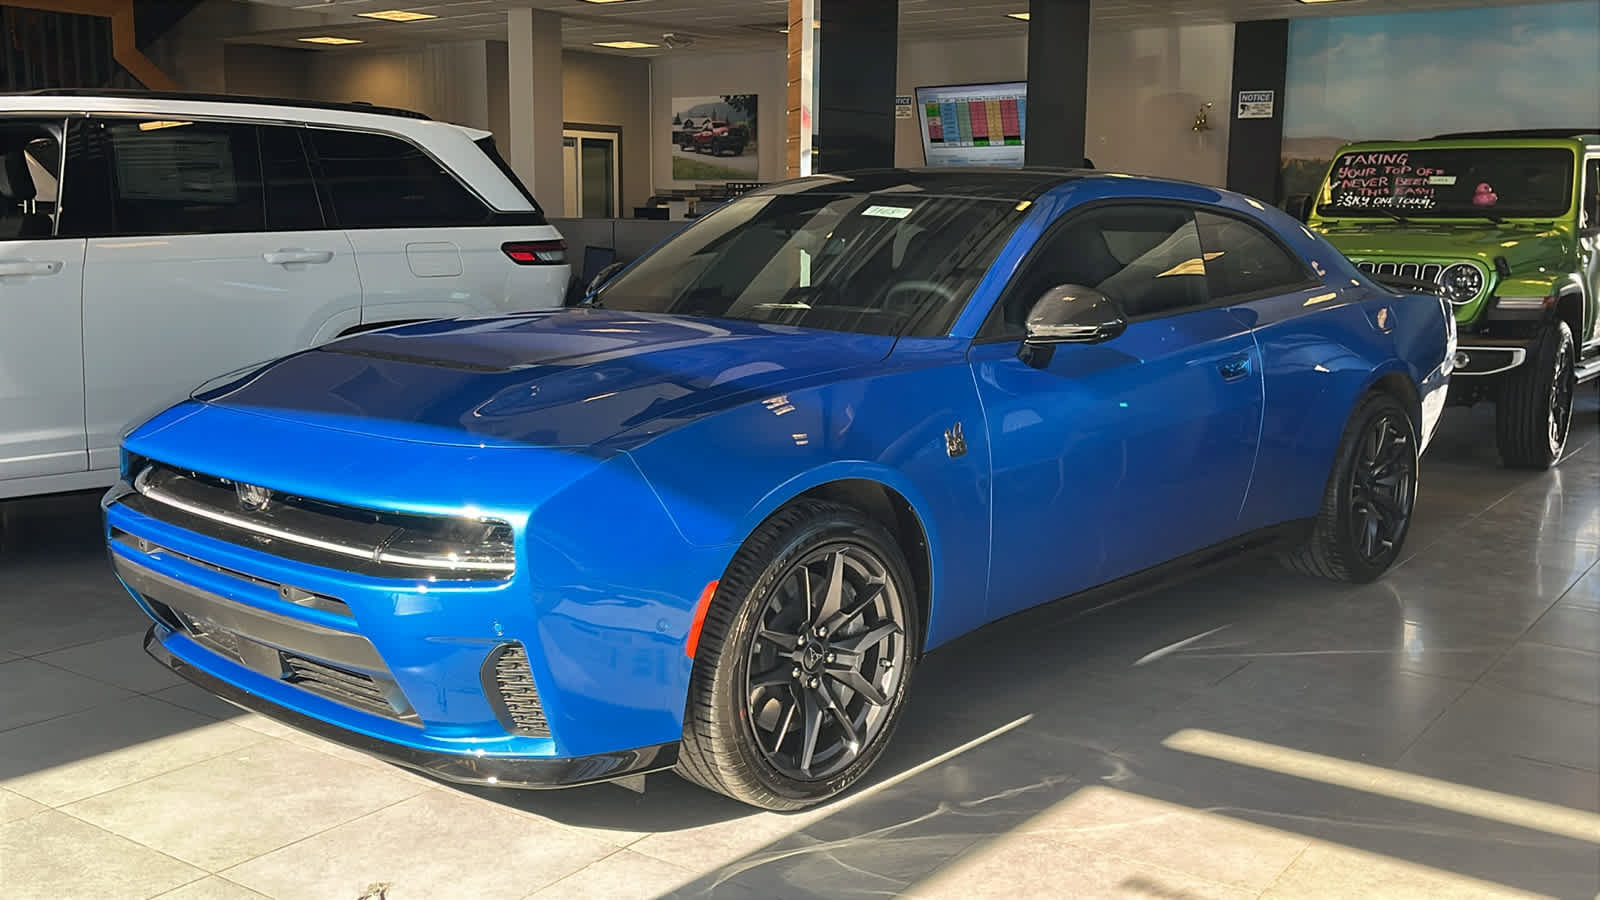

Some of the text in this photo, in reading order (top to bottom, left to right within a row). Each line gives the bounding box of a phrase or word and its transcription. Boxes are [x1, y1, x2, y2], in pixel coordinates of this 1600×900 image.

[1241, 94, 1270, 102] NOTICE
[1344, 153, 1408, 165] TAKING
[1338, 167, 1376, 178] YOUR
[1384, 166, 1412, 175] TOP
[1341, 176, 1388, 188] NEVER
[1360, 187, 1390, 196] THIS
[1344, 195, 1370, 206] SKY
